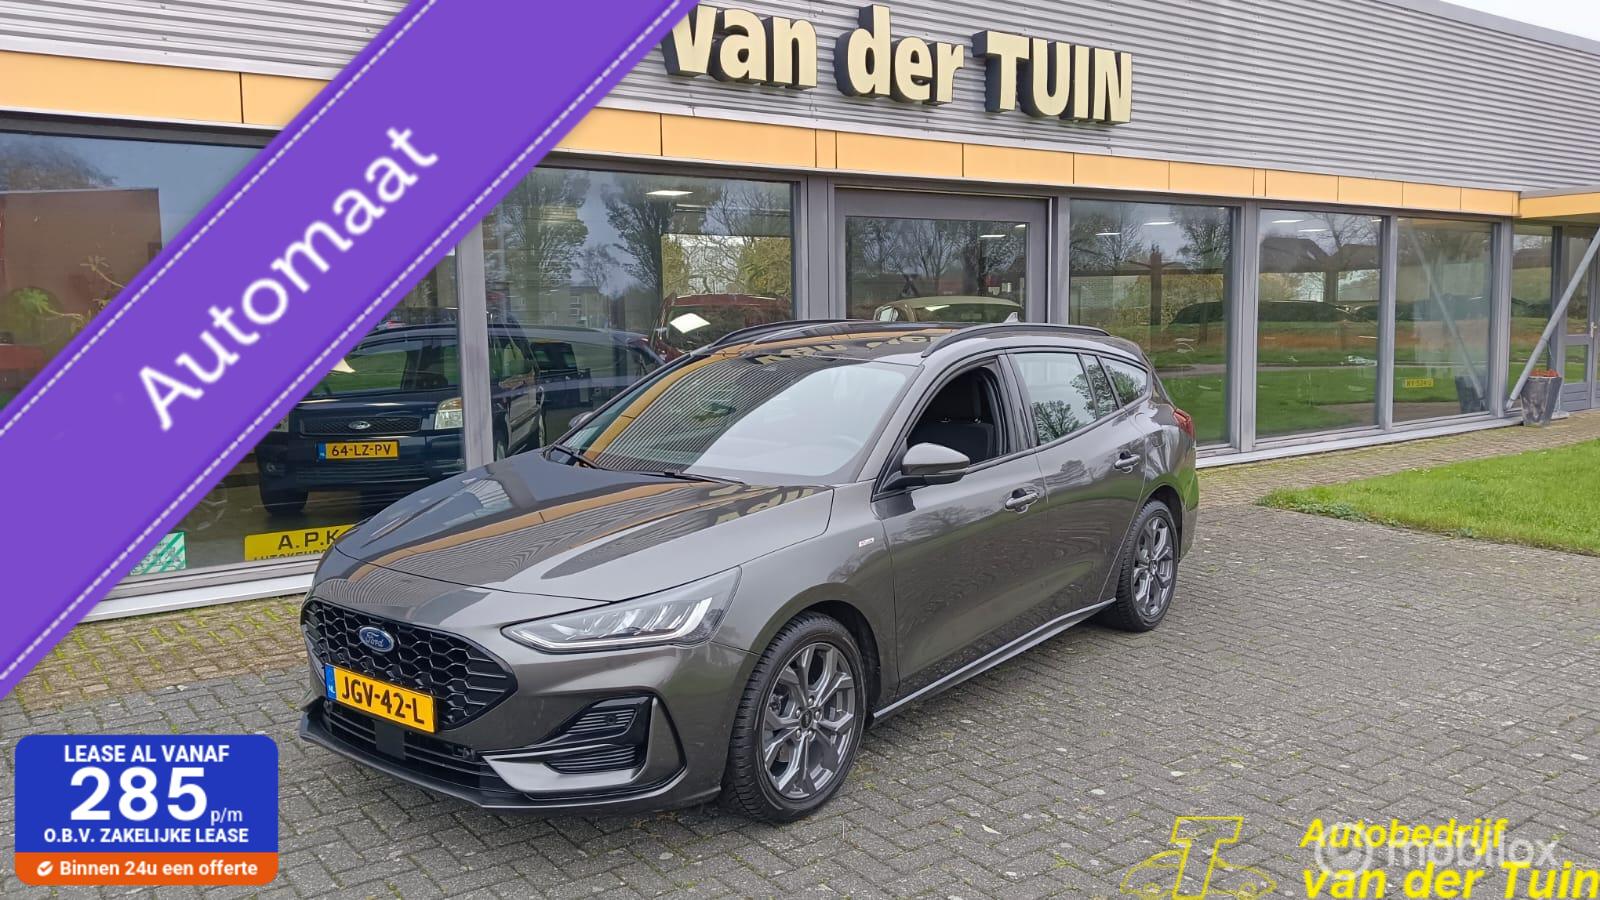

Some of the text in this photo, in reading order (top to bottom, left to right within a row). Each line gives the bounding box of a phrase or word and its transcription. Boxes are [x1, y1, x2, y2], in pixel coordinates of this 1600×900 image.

[668, 4, 1133, 124] van der TUIN
[330, 443, 392, 457] 64-LZ-PV
[341, 675, 426, 725] JGV-42-L
